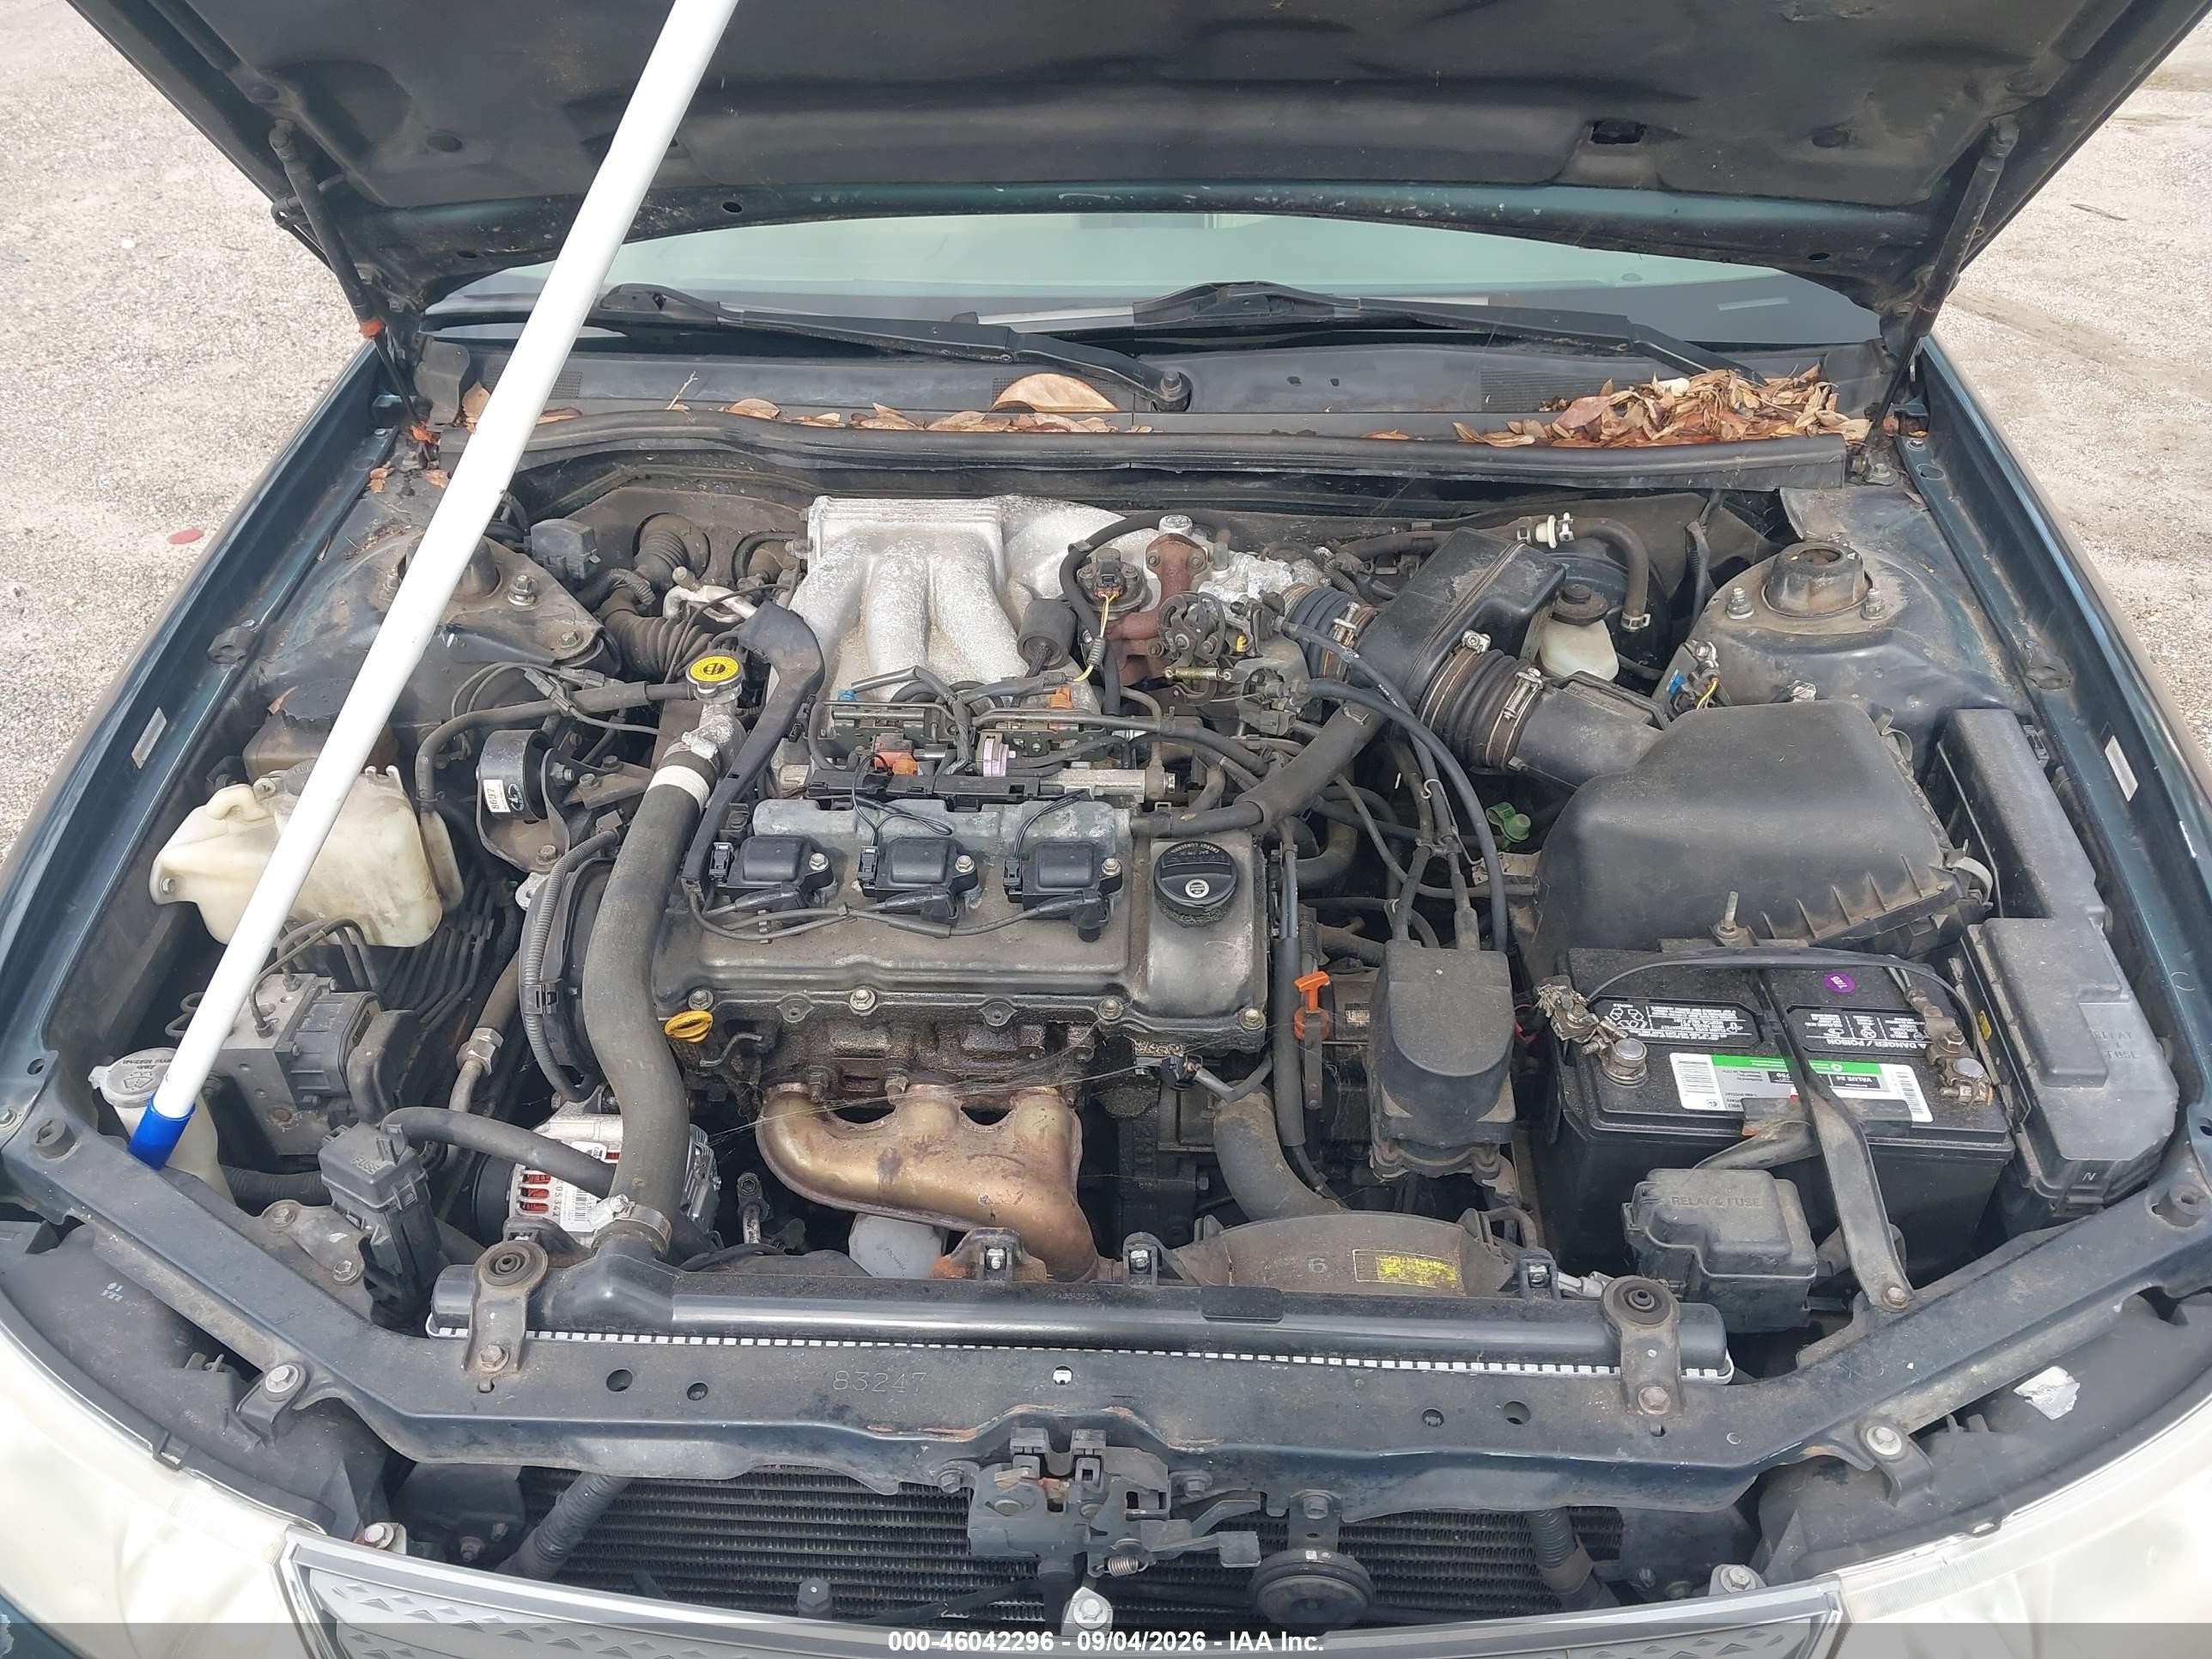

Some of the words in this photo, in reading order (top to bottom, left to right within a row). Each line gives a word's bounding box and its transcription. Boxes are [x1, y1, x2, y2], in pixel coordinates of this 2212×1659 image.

[1826, 1037, 1866, 1047] POISON
[1875, 1040, 1917, 1049] DANGER
[2106, 1049, 2138, 1059] FUSE
[351, 1155, 380, 1174] FUSE
[1671, 1195, 1713, 1207] RELAY
[1727, 1197, 1764, 1208] FUSE
[833, 1370, 927, 1395] 83247
